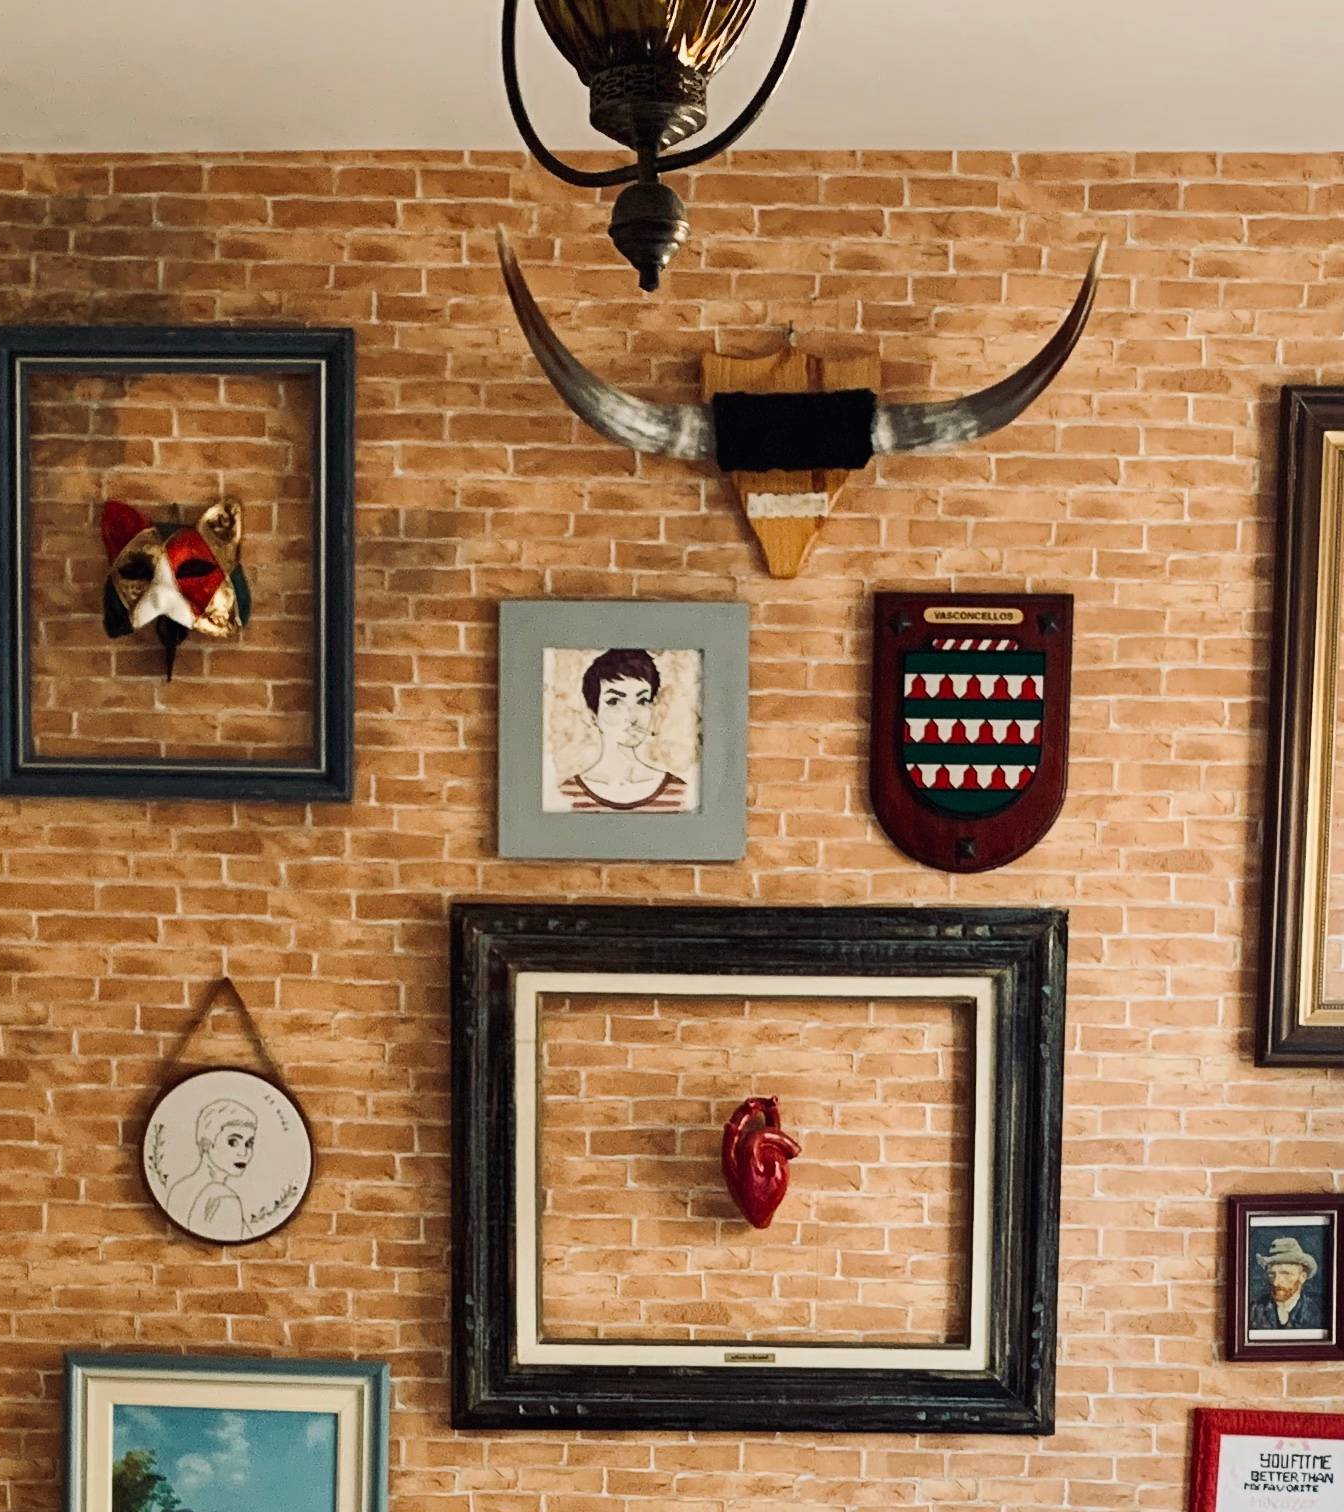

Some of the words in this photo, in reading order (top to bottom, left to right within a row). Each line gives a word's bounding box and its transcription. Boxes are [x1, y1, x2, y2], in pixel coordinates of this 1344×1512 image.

[934, 611, 1014, 621] VASCONCELLOS
[1260, 1453, 1289, 1469] YOU
[1291, 1454, 1311, 1469] FIT
[1312, 1454, 1332, 1470] ME
[1251, 1470, 1299, 1483] BETTER
[1301, 1472, 1334, 1484] THAN
[1244, 1482, 1260, 1491] MY
[1262, 1483, 1319, 1492] FAVORITE
